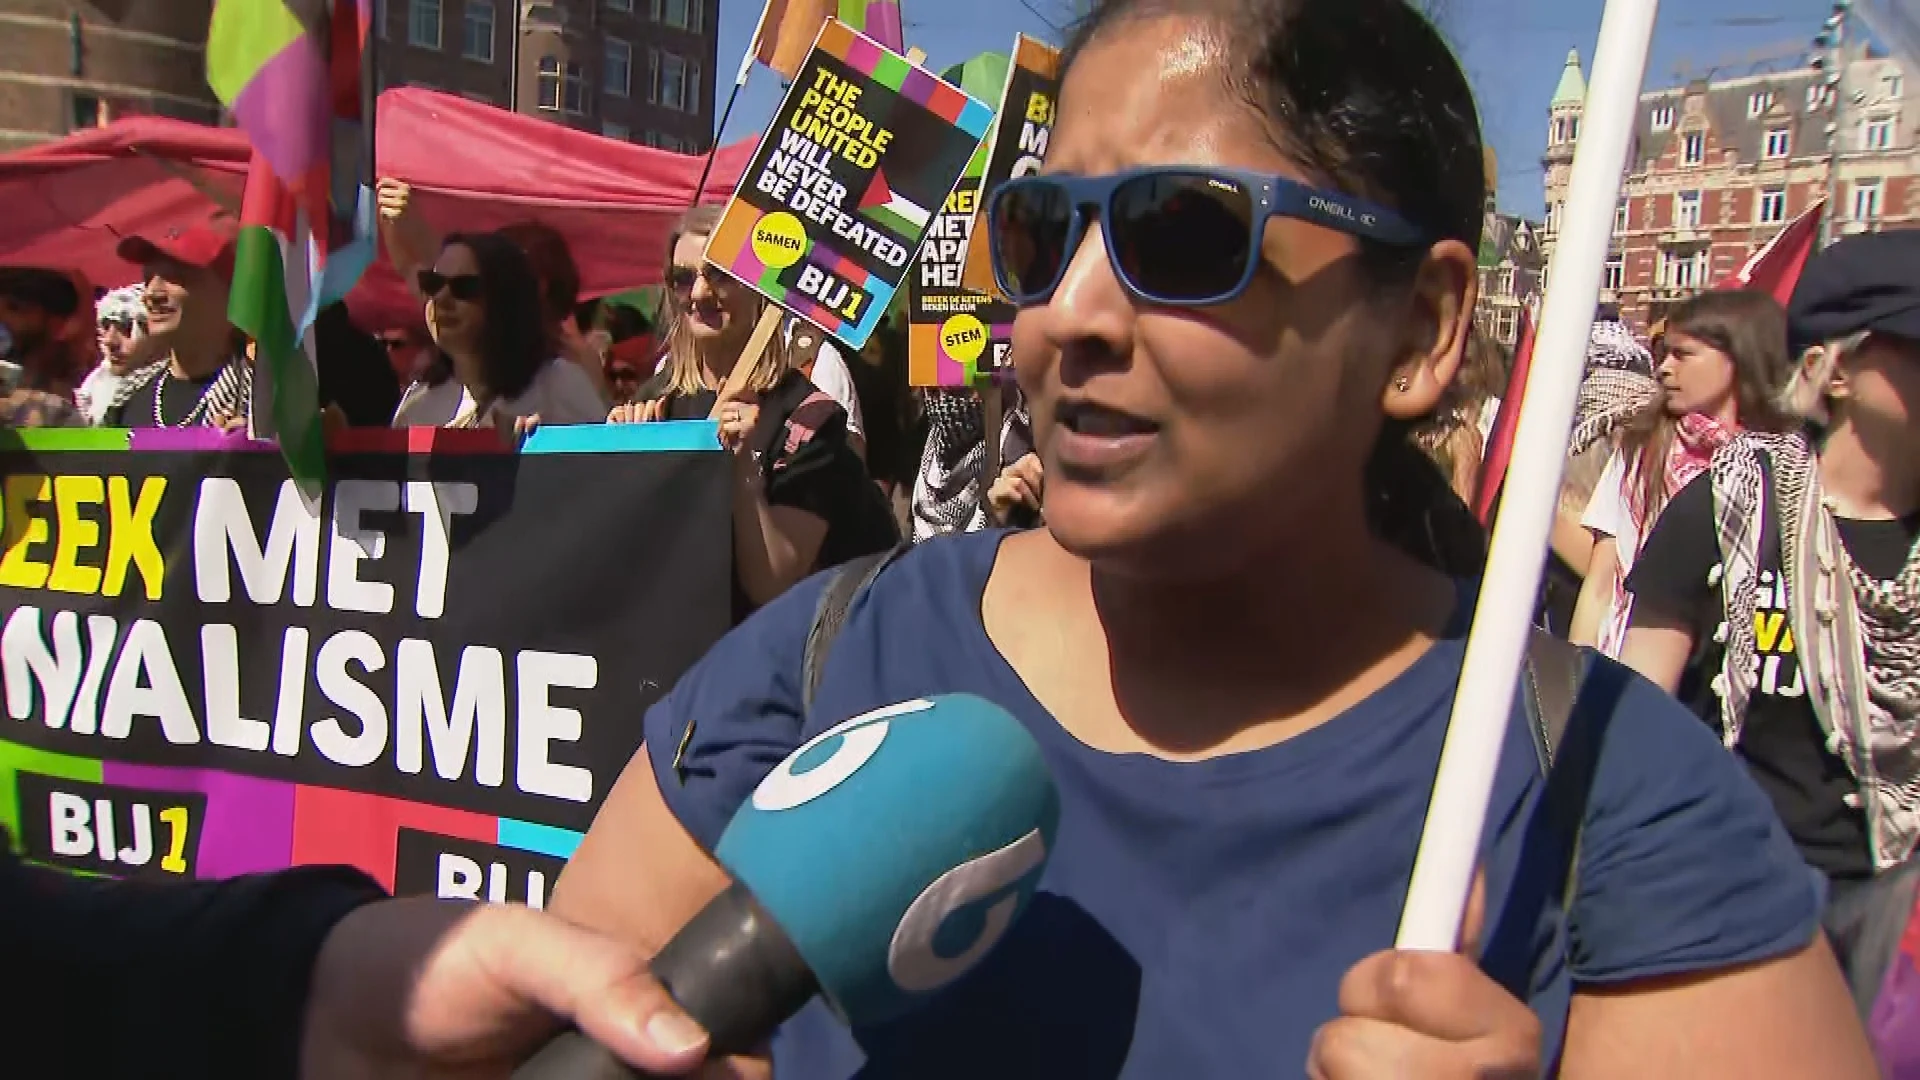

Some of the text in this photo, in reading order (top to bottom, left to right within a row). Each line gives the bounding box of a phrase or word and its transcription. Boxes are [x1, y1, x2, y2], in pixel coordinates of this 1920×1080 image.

[813, 66, 863, 109] THE
[790, 107, 877, 169] UNITED
[800, 87, 894, 154] PEOPLE
[767, 149, 848, 208] NEVER
[780, 127, 832, 176] WILL
[756, 169, 908, 267] BE DEFEATED
[756, 229, 801, 251] SAMEN
[796, 263, 863, 321] BIJ1
[945, 328, 982, 347] STEM
[0, 475, 479, 619] EEK MET
[0, 605, 598, 803] NIALISME
[48, 790, 190, 874] BIJ1
